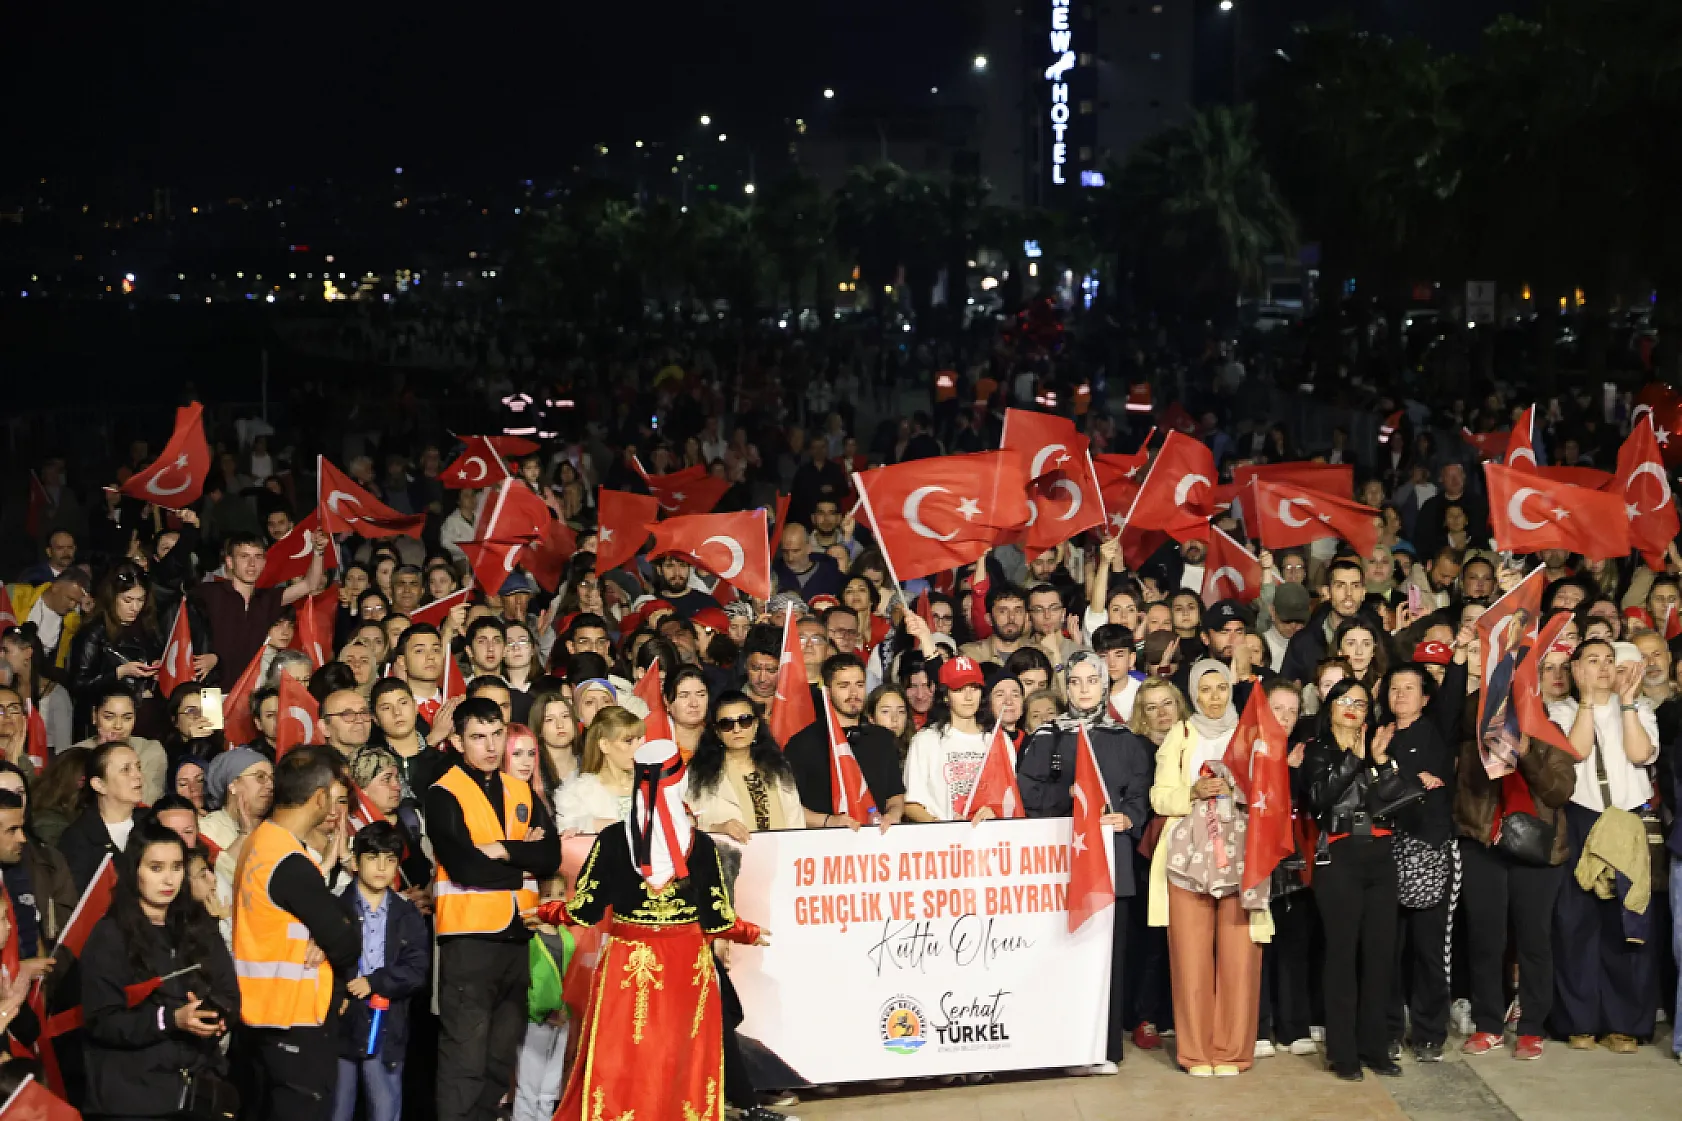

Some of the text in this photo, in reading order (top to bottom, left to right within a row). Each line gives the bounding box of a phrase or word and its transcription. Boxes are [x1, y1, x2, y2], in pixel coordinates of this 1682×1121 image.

[1051, 82, 1069, 184] HOTEL
[794, 857, 816, 887] 19
[823, 853, 891, 885] MAYIS
[1019, 844, 1069, 875] ANM
[889, 891, 916, 921] VE
[923, 888, 977, 919] SPOR
[949, 913, 1037, 971] Olsun
[929, 988, 1013, 1029] Serhat
[935, 1020, 1010, 1044] TÜRKEL
